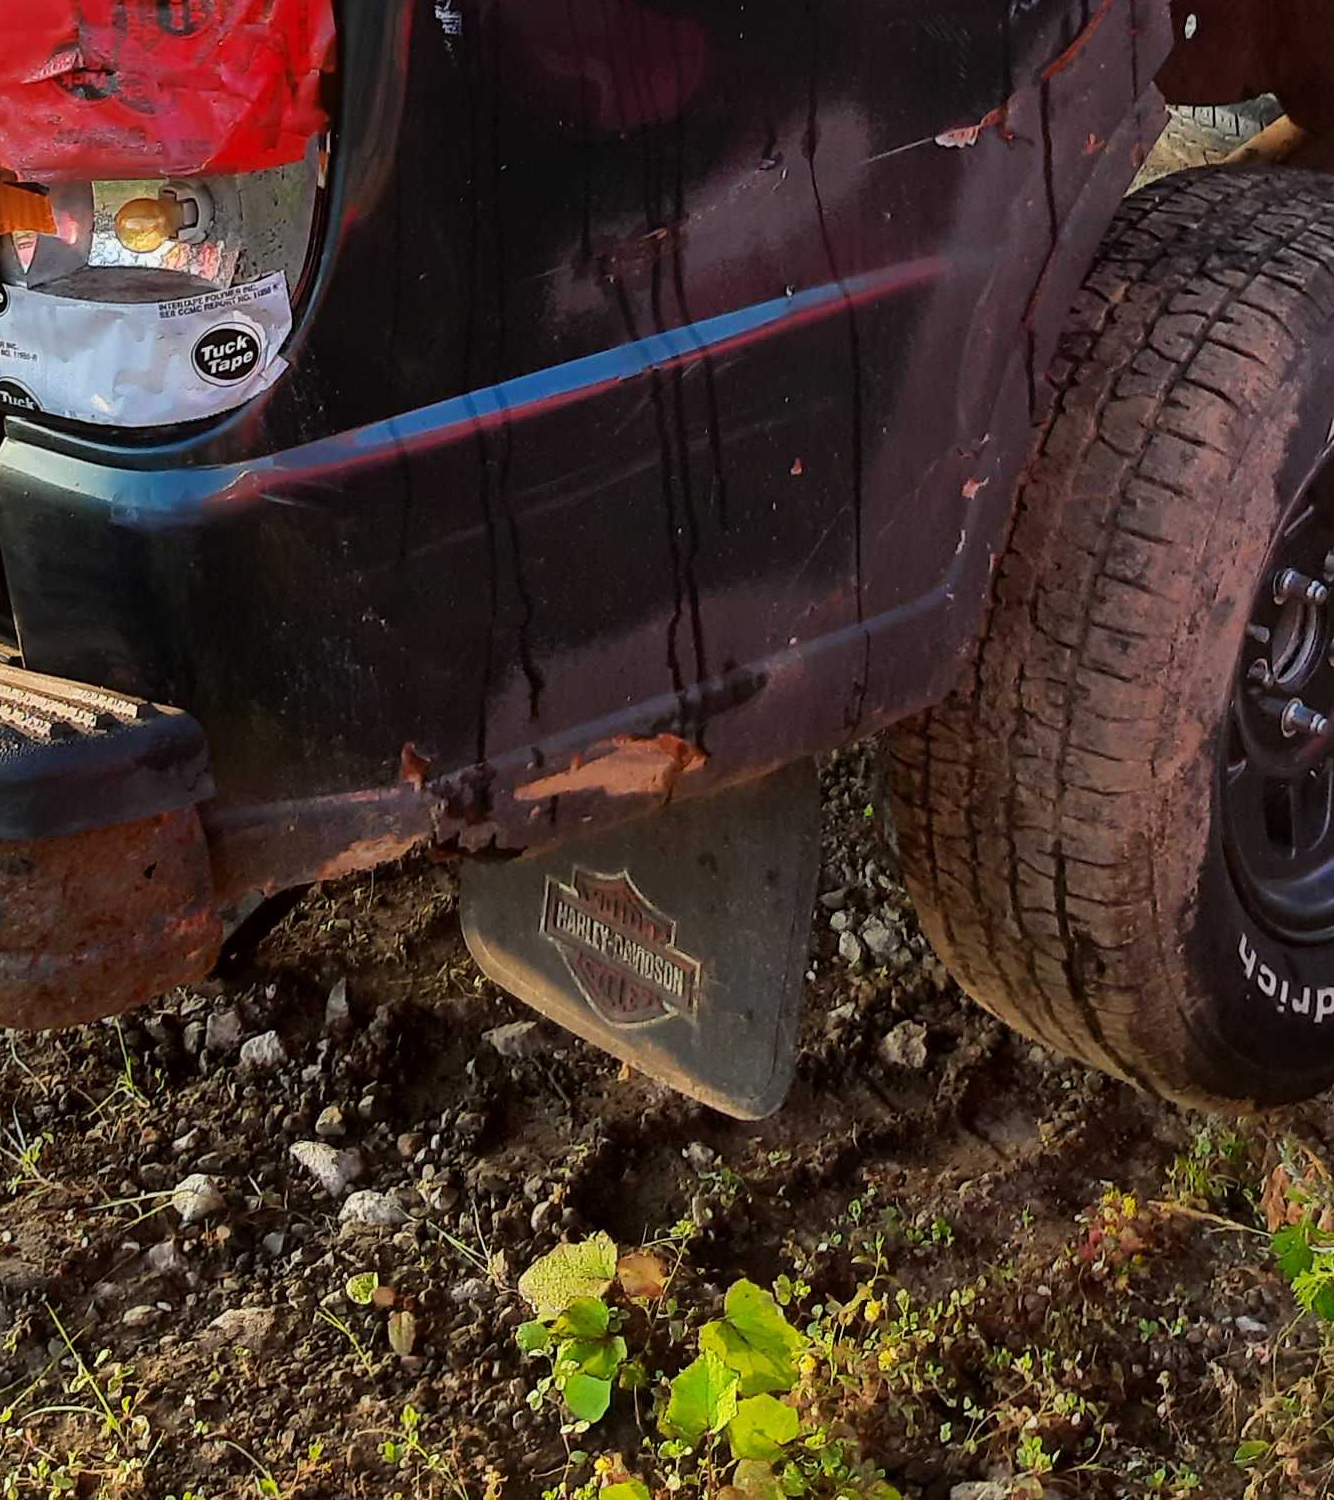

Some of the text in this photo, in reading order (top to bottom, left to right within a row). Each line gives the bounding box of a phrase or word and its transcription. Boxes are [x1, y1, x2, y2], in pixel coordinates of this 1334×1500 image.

[201, 335, 249, 362] Tuck
[207, 350, 254, 374] Tape
[556, 901, 684, 997] HARLEY-DAVIDSON
